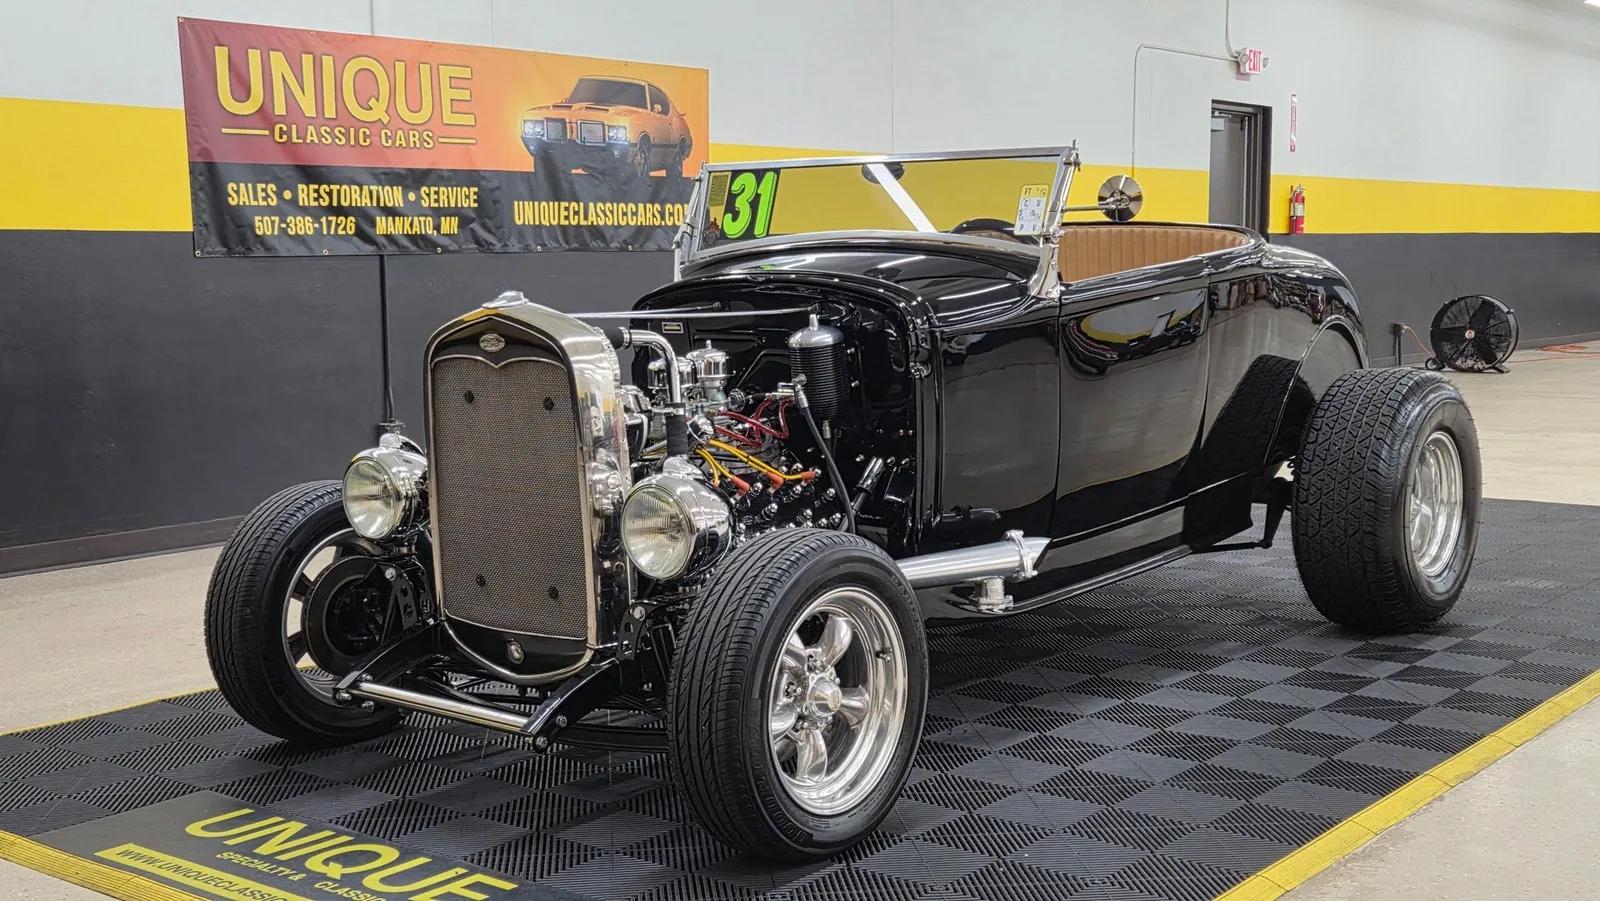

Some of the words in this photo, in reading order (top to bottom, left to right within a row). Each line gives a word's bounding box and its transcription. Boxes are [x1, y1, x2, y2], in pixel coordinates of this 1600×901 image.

[1248, 49, 1262, 72] EXIT
[214, 46, 476, 126] UNIQUE
[273, 124, 371, 146] CLASSIC
[380, 129, 434, 149] CARS
[227, 182, 277, 206] SALES
[297, 183, 404, 208] RESTORATION
[420, 186, 479, 208] SERVICE
[722, 171, 778, 239] 31
[254, 215, 356, 236] 507-386-1726
[376, 216, 437, 237] MANKATO,
[441, 216, 458, 235] MN
[185, 807, 519, 901] UNIQUE
[216, 850, 298, 877] SPECIALTY
[287, 873, 307, 881] &
